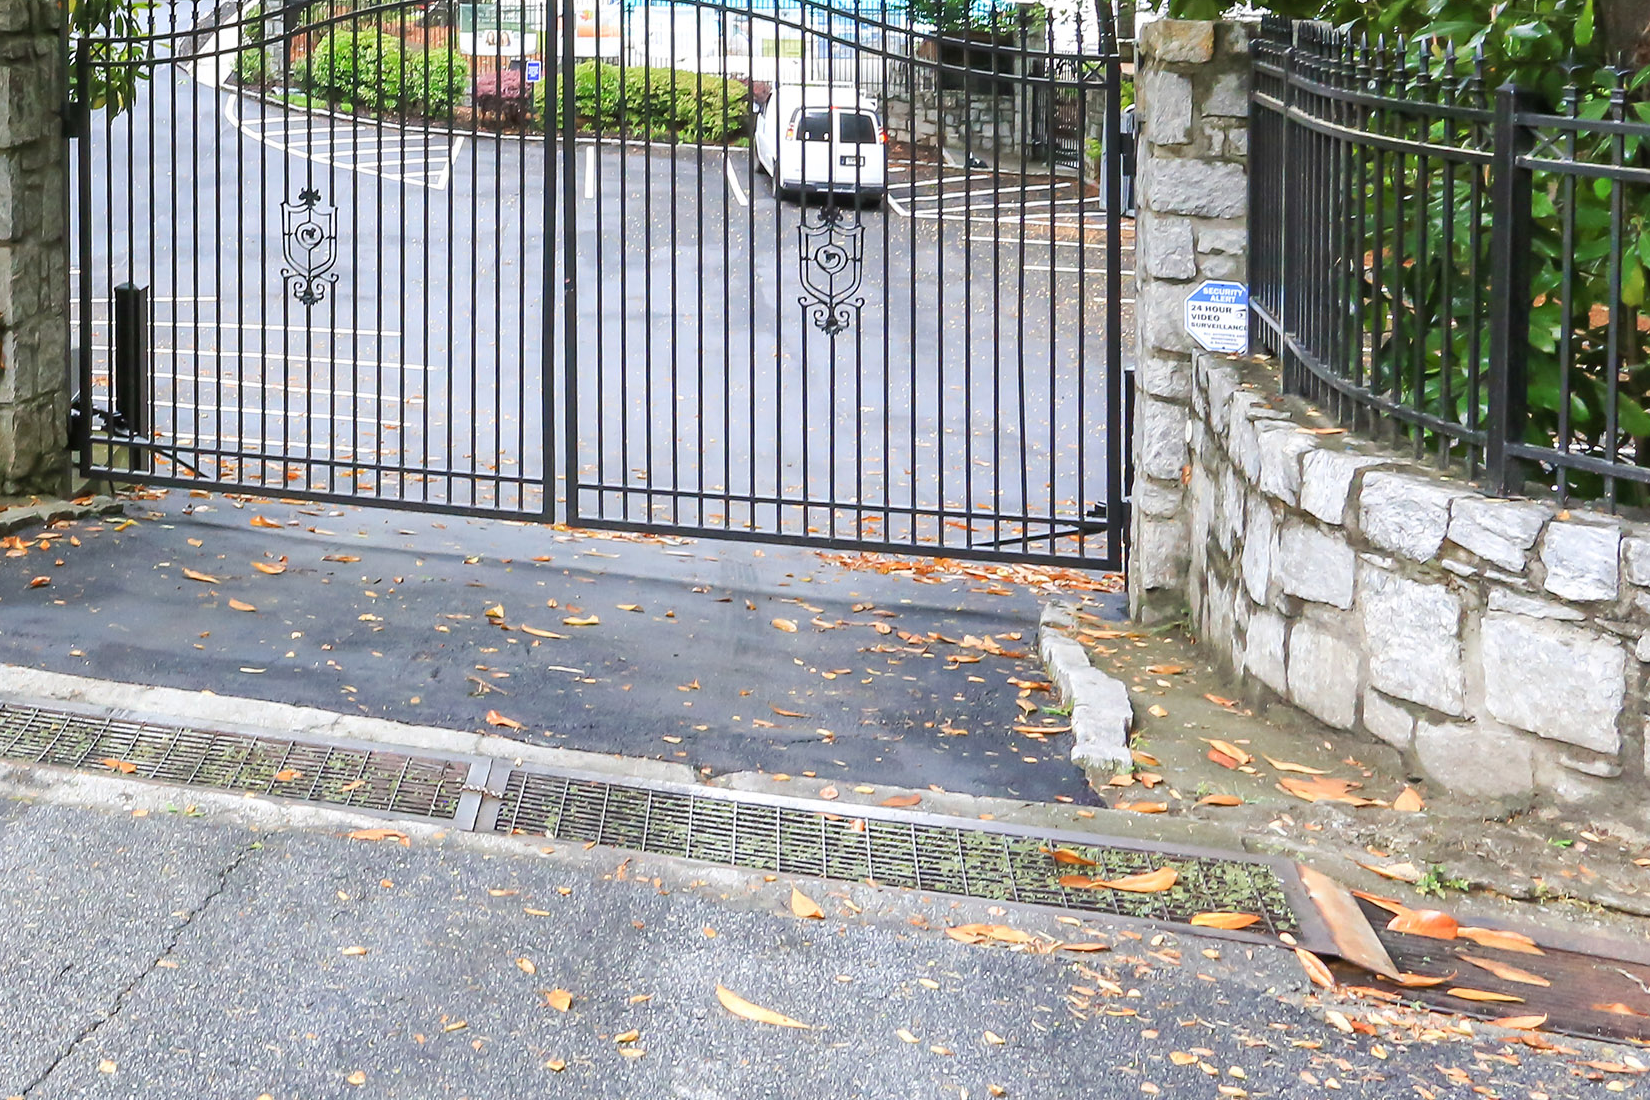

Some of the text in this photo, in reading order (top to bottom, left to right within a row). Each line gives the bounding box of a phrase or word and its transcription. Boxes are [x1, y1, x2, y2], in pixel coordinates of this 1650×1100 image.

[1203, 287, 1243, 296] SECURITY
[1210, 295, 1236, 303] ALERT
[1191, 304, 1232, 314] 24 HOUR
[1191, 313, 1220, 322] VIDEO
